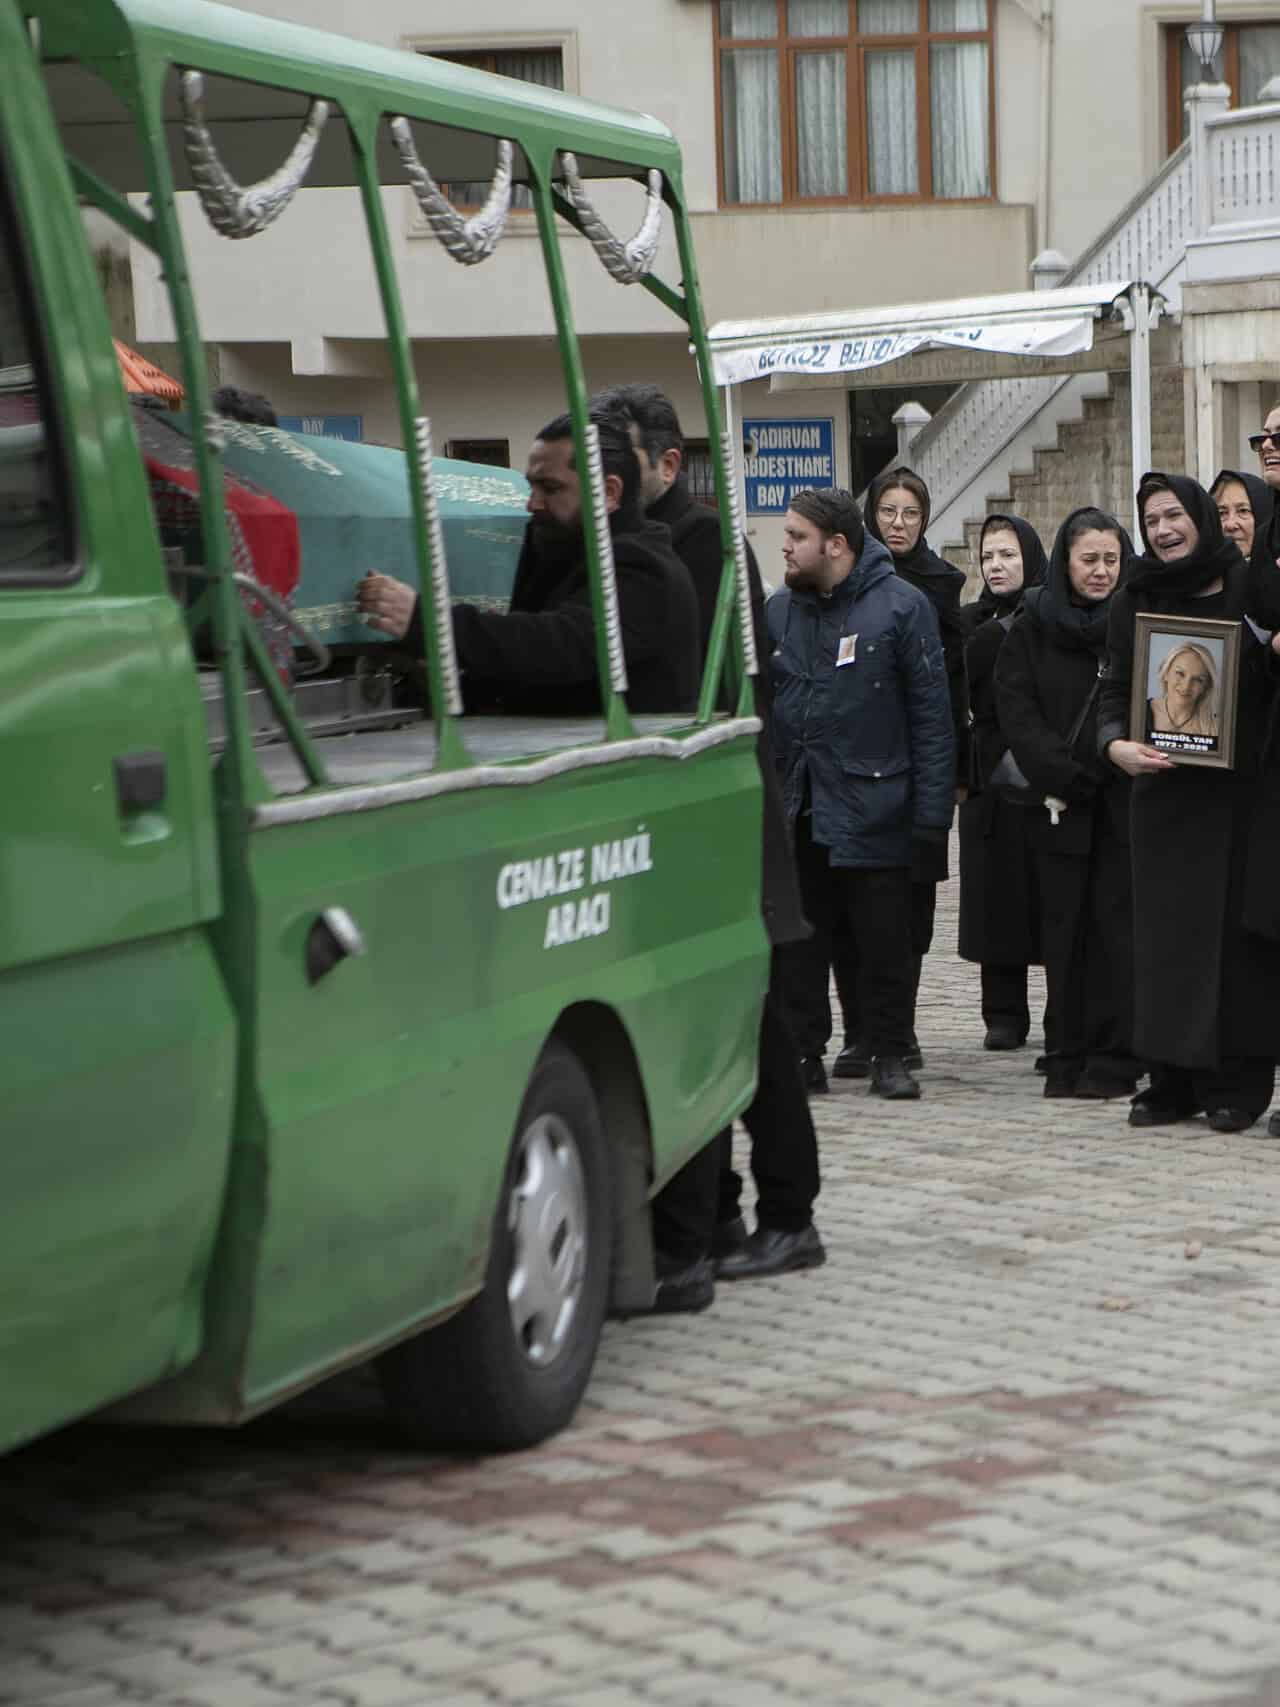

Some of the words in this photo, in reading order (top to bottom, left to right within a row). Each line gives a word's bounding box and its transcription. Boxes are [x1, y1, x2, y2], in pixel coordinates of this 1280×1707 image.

[757, 485, 785, 507] BAY
[496, 848, 585, 909] CENAZE
[591, 824, 653, 885] NAKİL
[543, 891, 611, 949] ARACI
